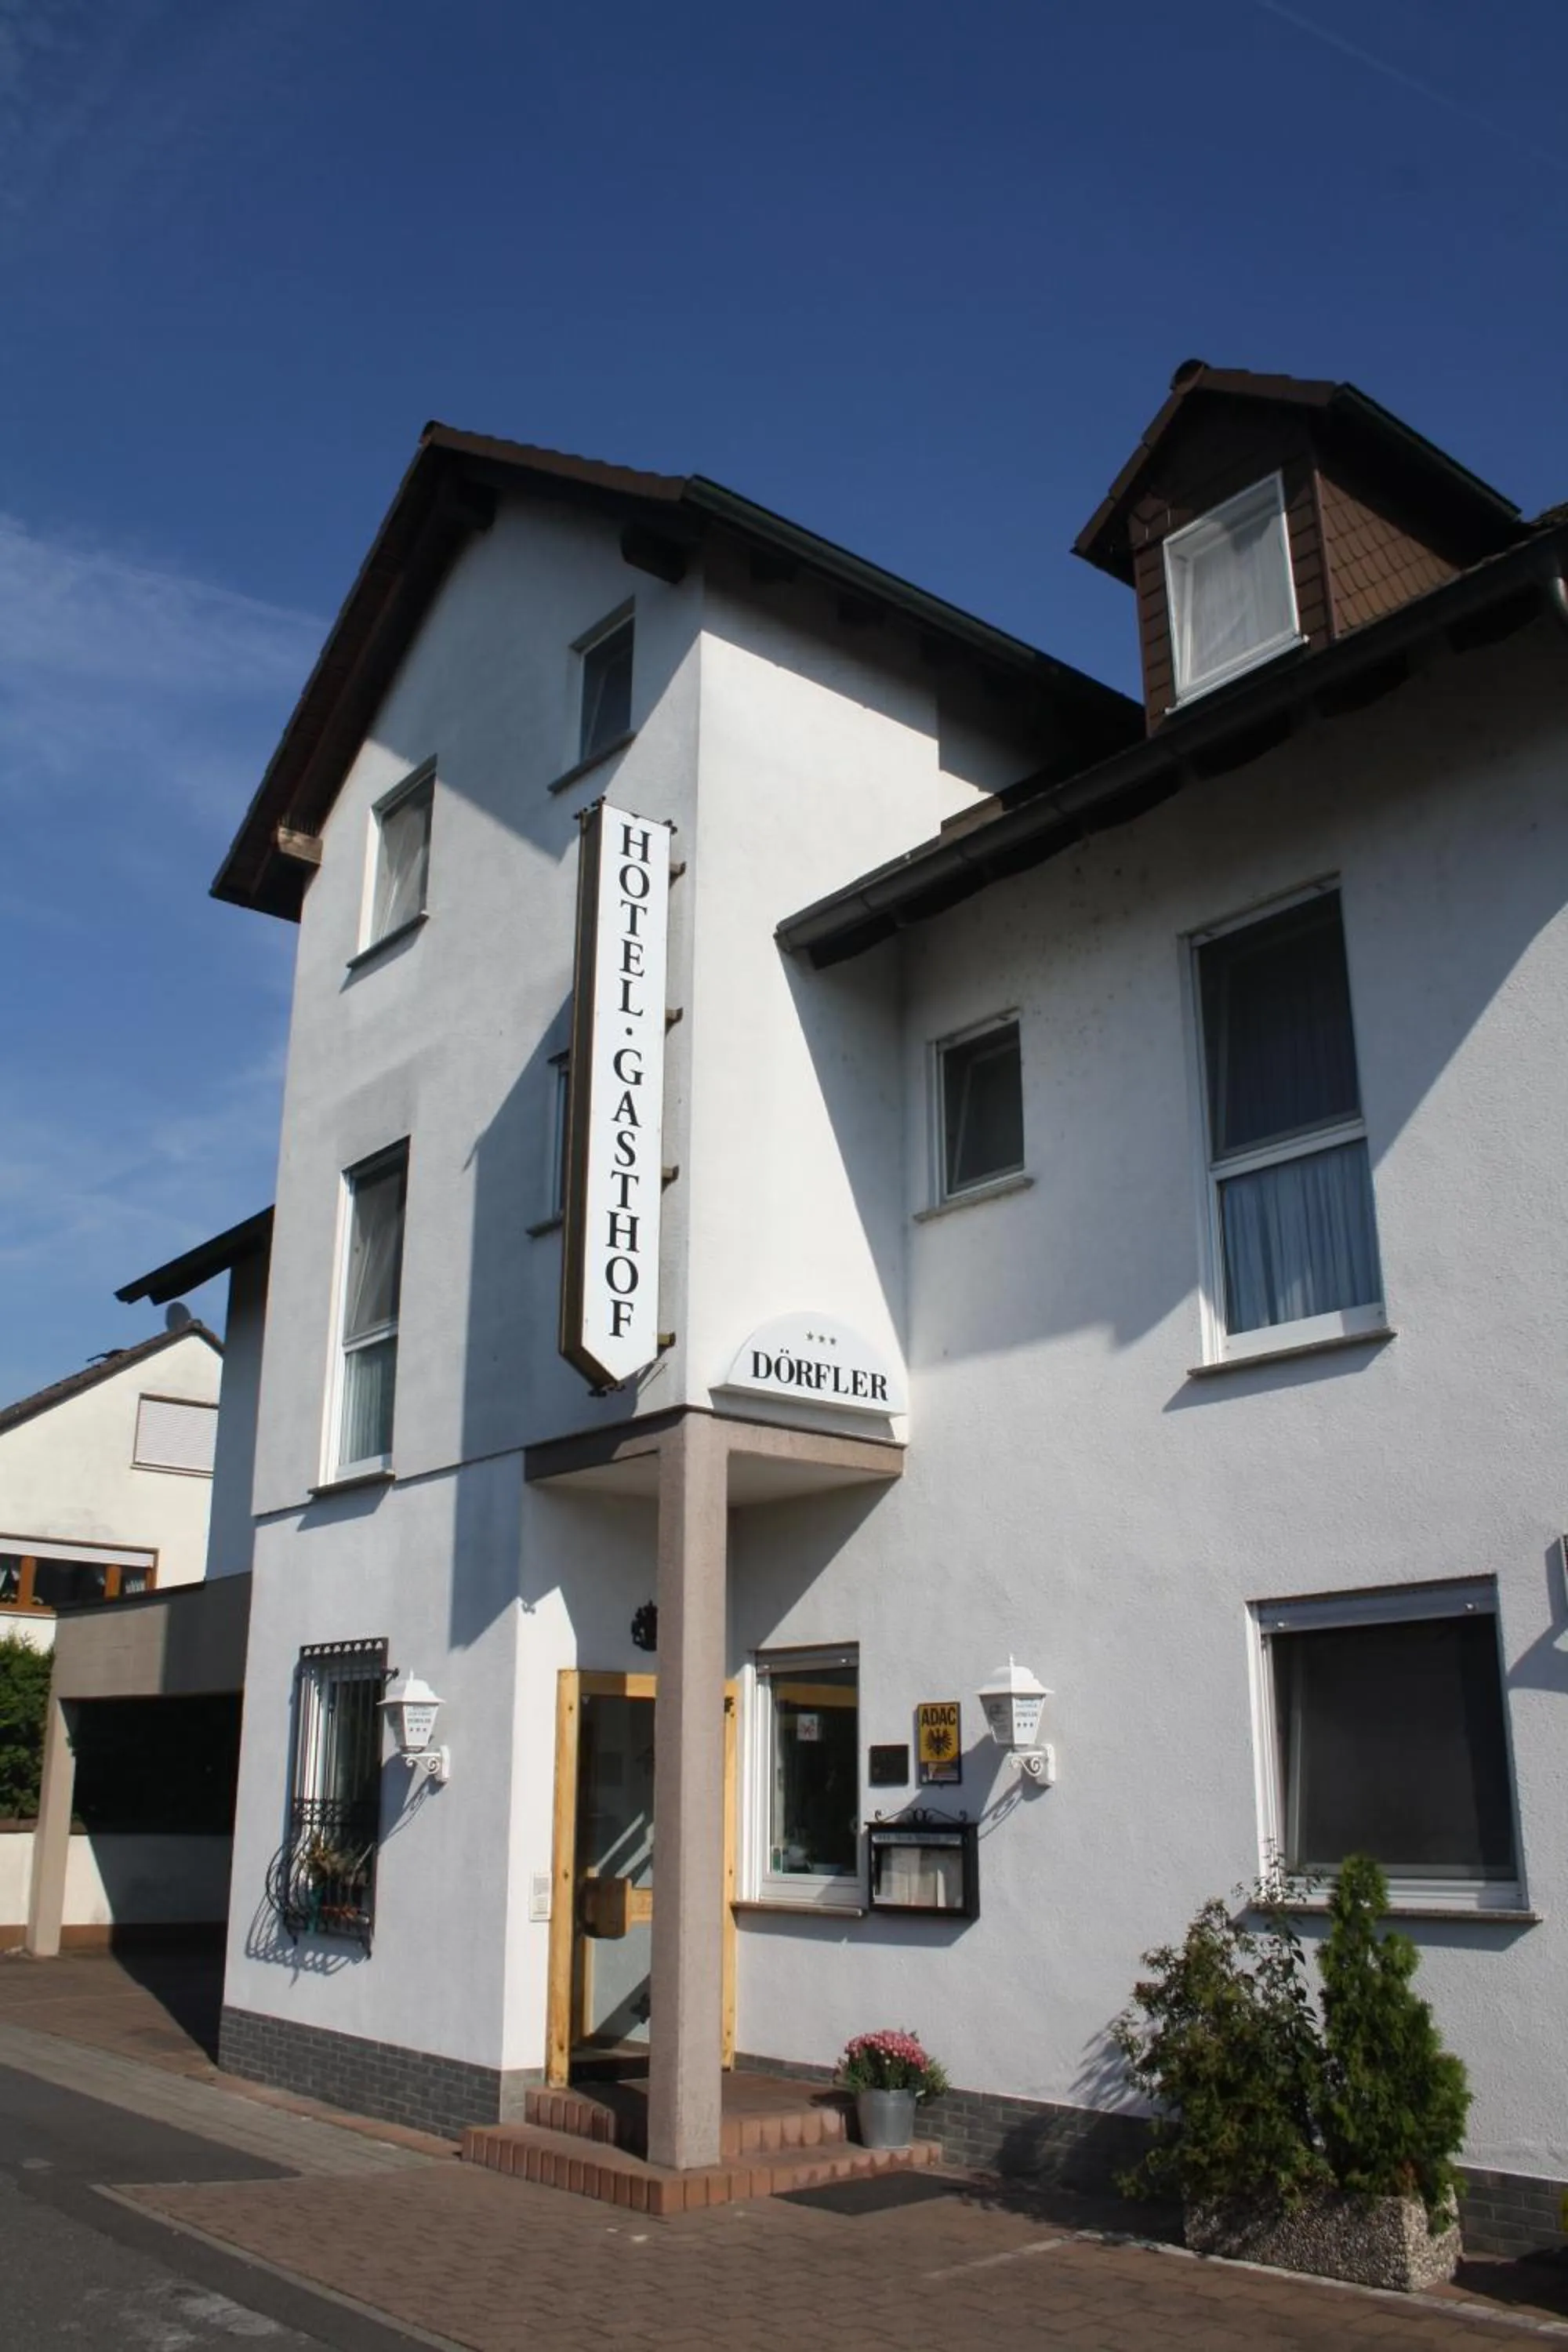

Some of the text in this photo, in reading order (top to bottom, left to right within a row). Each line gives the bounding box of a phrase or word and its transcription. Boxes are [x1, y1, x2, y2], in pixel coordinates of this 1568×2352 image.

[604, 822, 652, 1338] HOTEL GASTHOF
[750, 1348, 888, 1402] DÖRFLER
[921, 1705, 956, 1727] ADAC
